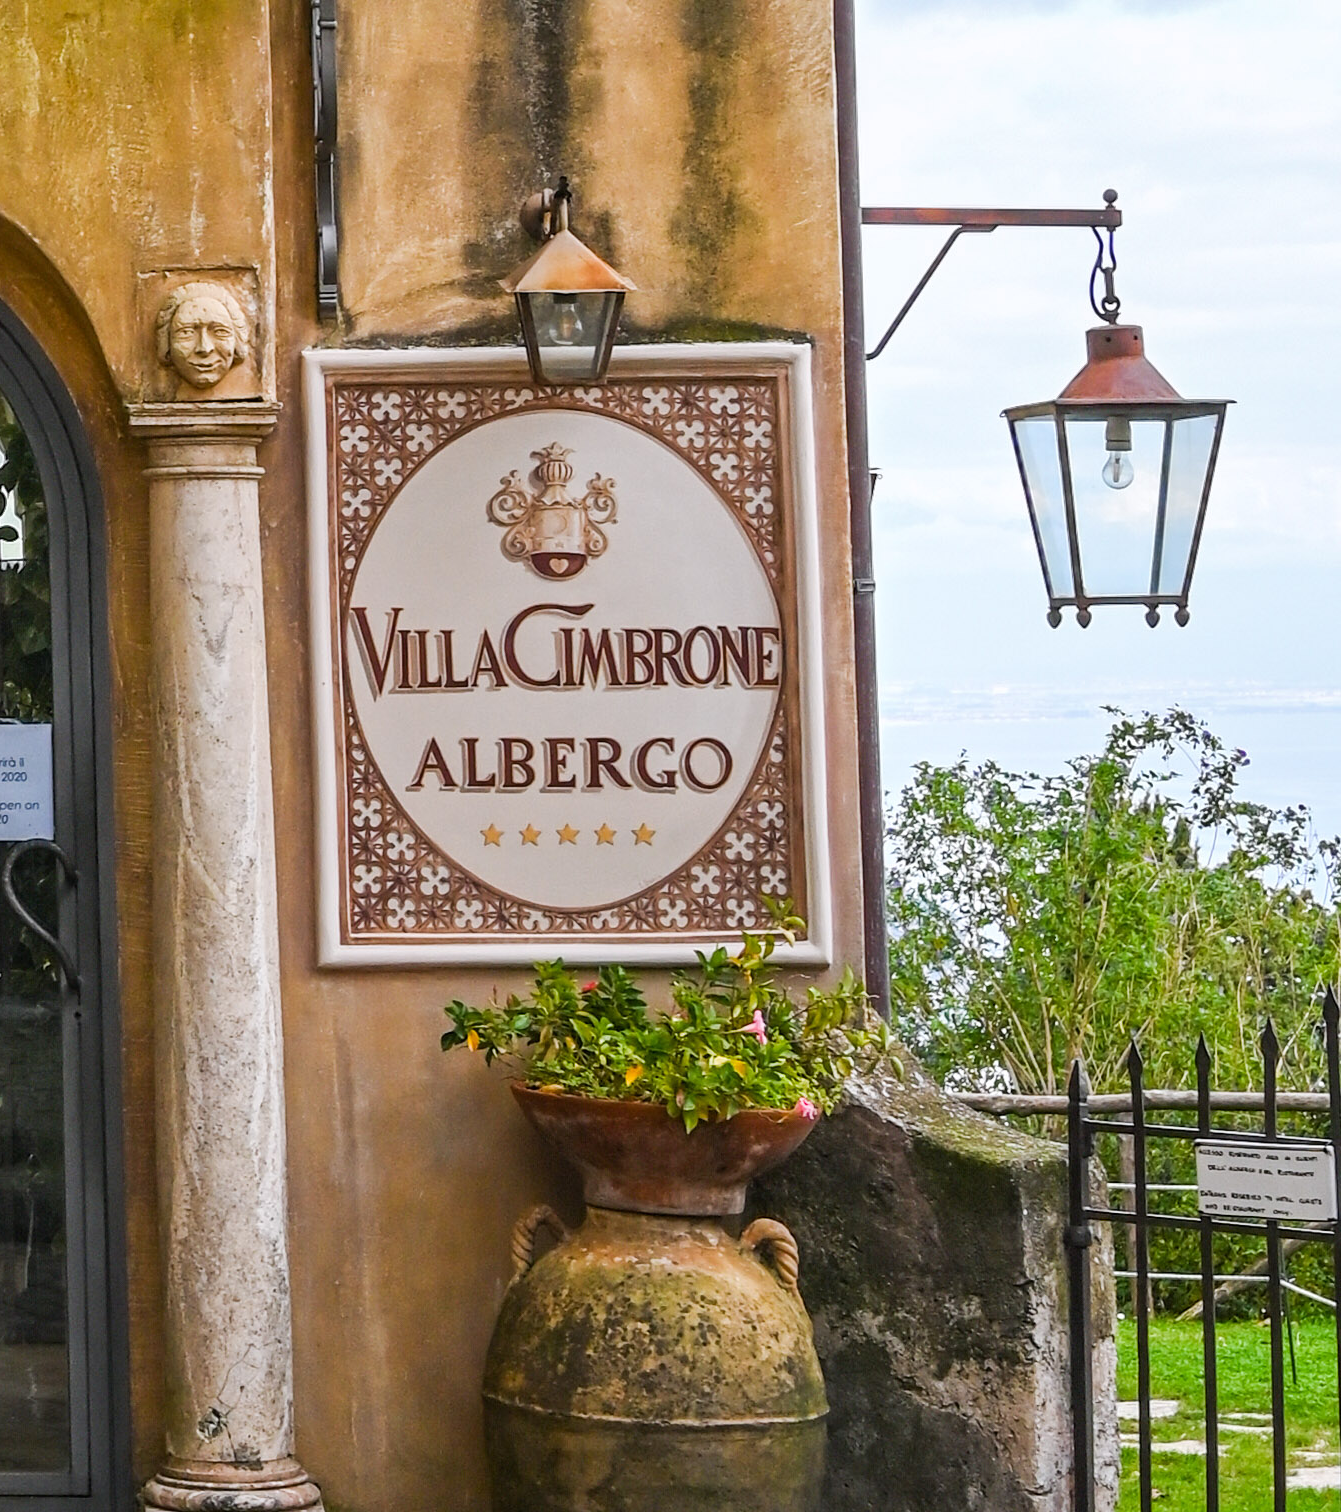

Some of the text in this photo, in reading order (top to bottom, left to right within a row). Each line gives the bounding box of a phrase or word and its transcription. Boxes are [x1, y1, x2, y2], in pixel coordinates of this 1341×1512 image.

[351, 603, 781, 700] VILLA CIMBRONE
[1, 772, 28, 782] 2020
[19, 757, 25, 767] il
[408, 735, 733, 793] ALBERGO
